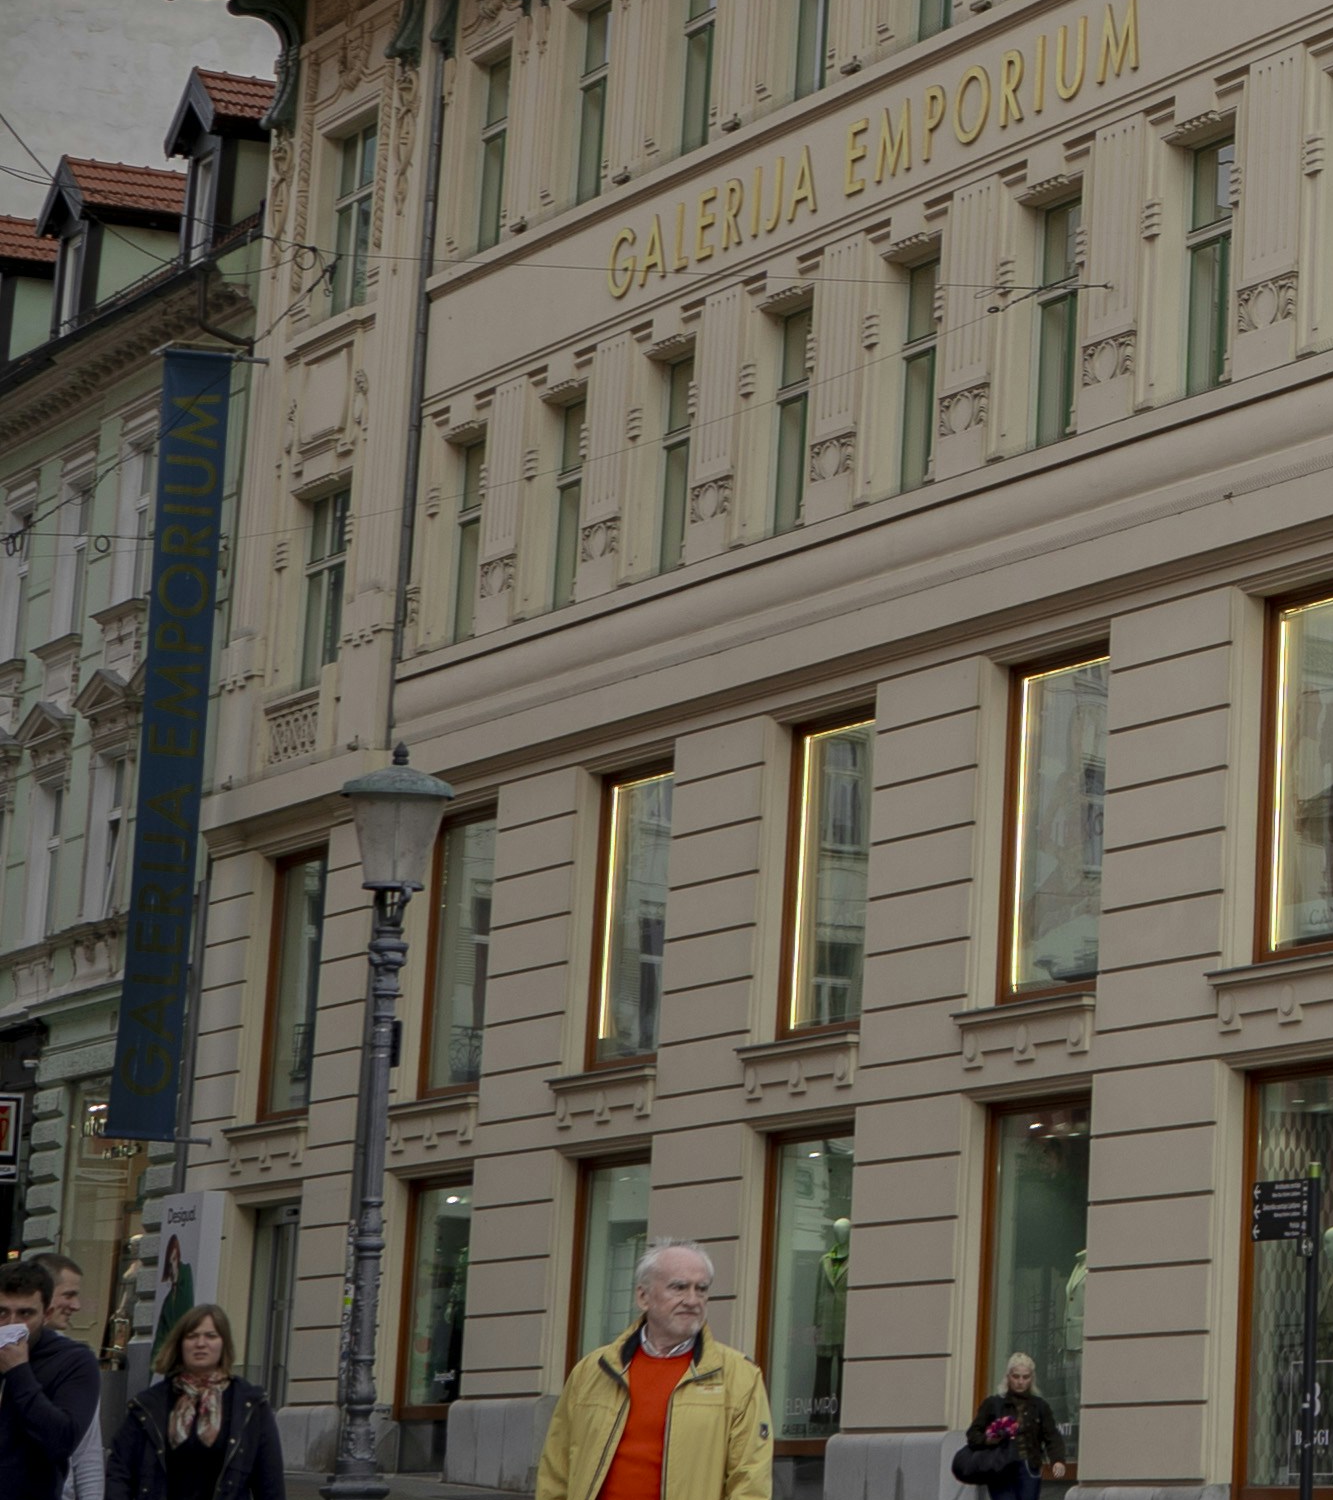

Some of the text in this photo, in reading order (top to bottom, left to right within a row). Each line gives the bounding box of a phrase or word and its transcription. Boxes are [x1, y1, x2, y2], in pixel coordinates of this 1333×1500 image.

[607, 144, 818, 299] GALERIJA
[120, 393, 224, 1097] GALERIJA EMPORIUM
